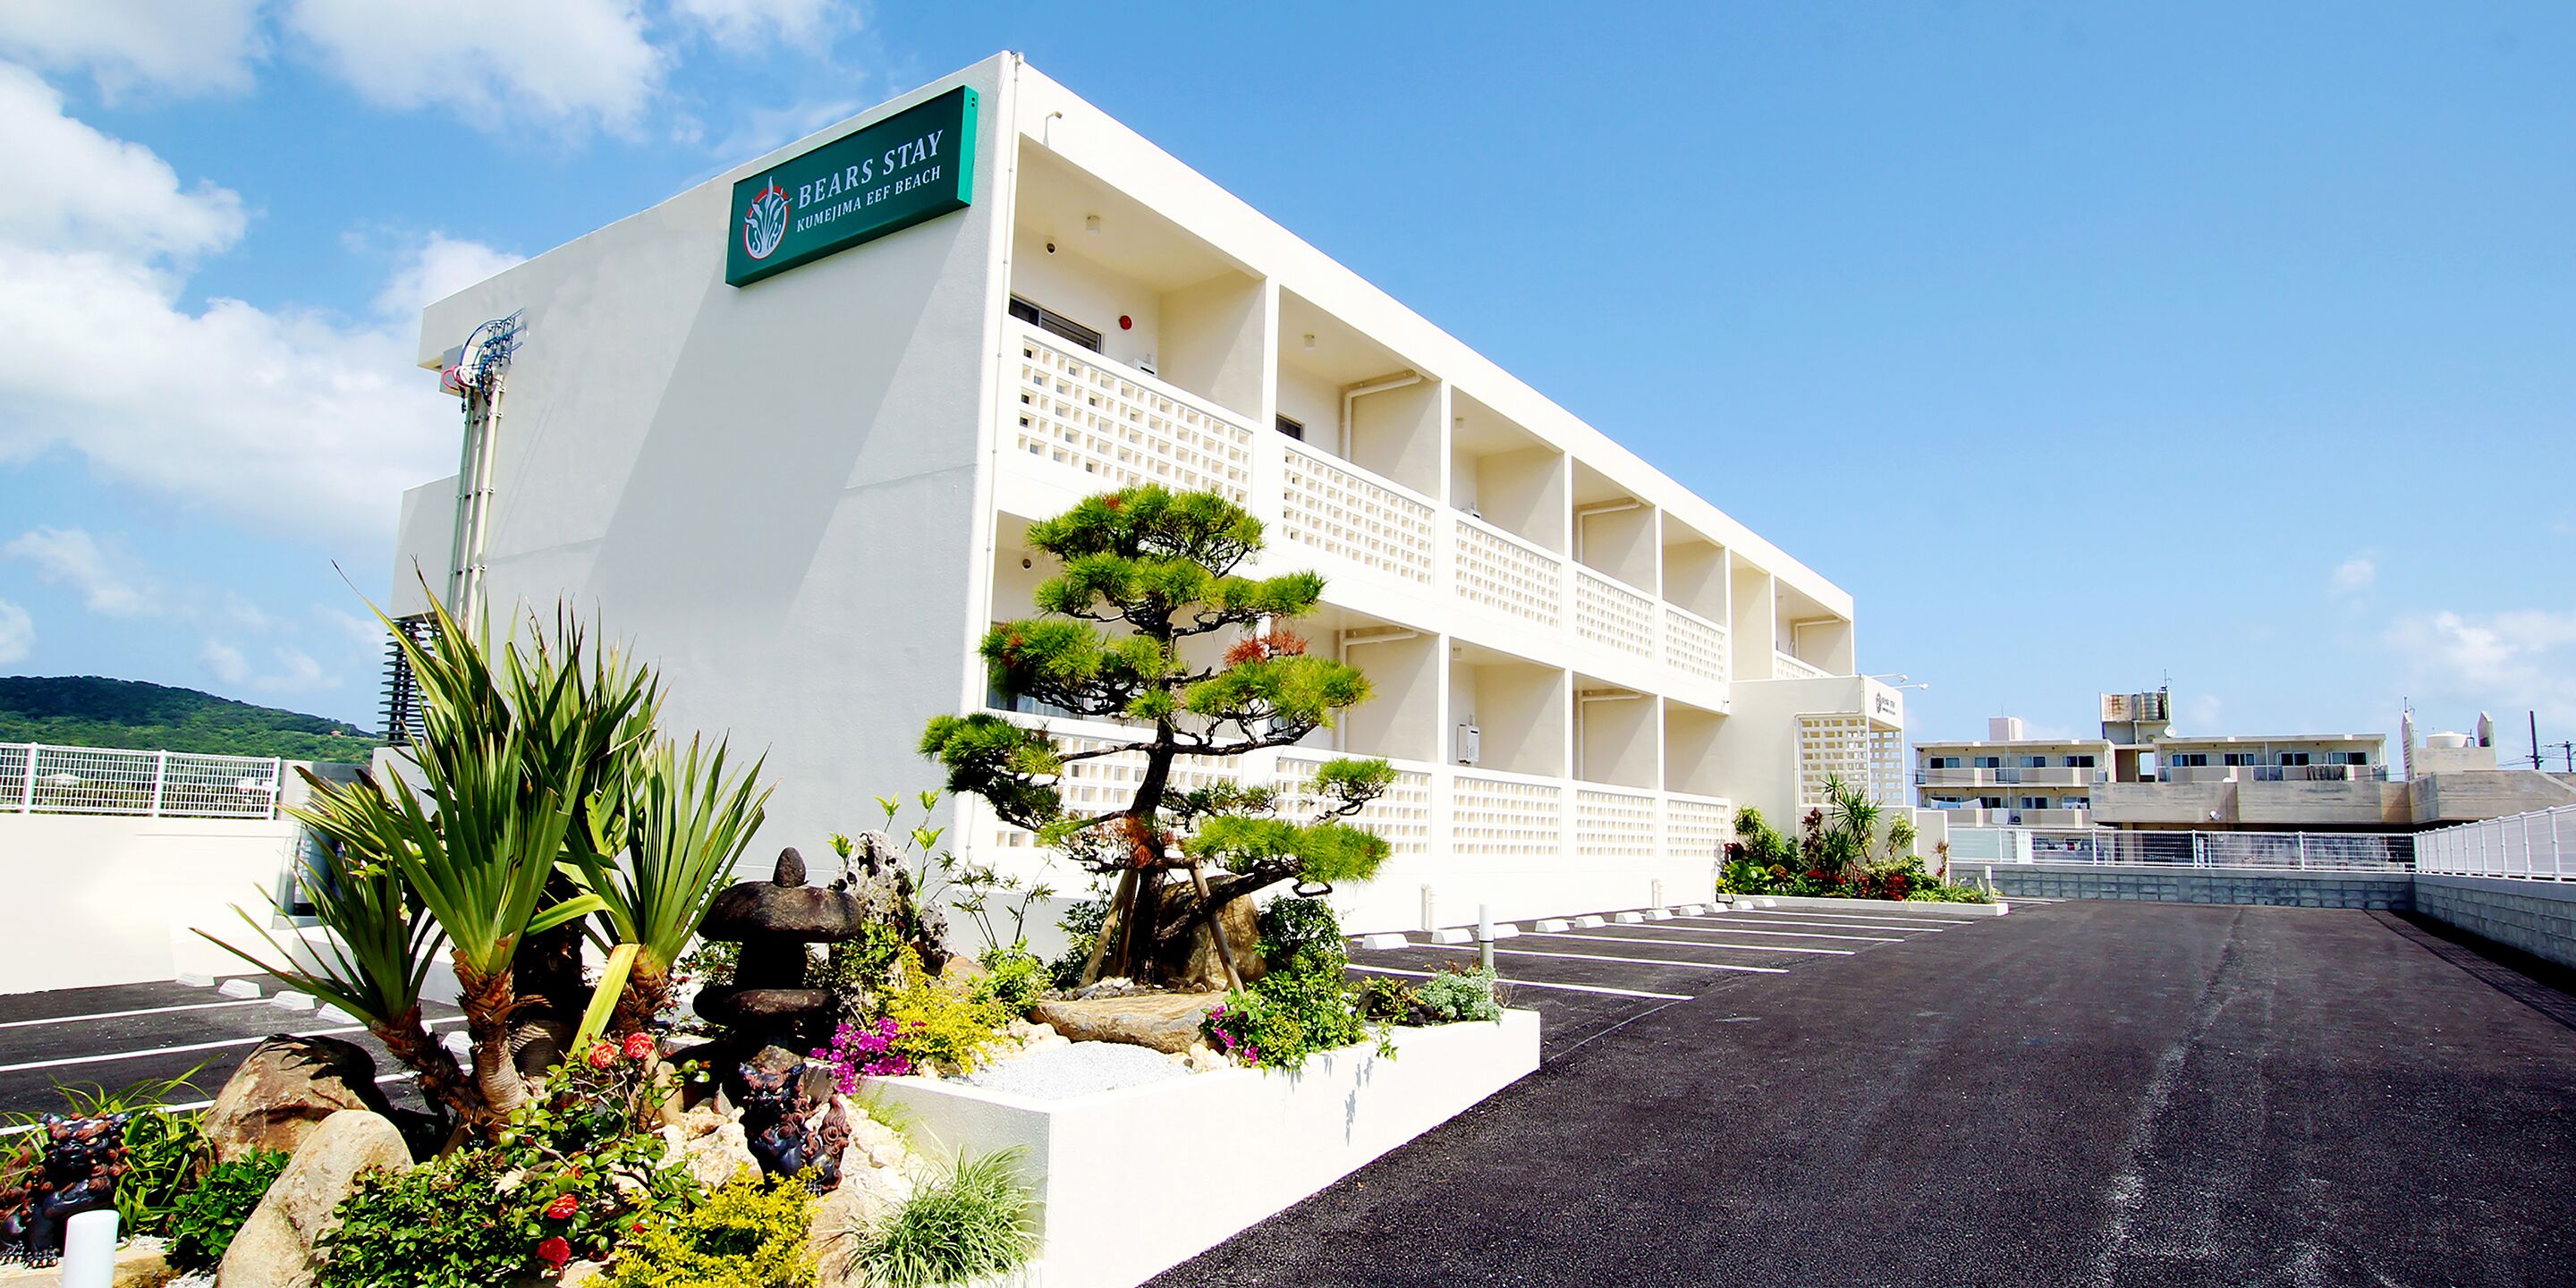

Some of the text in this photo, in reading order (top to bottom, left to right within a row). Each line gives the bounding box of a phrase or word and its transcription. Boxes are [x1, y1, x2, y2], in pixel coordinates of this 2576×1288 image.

[796, 165, 941, 233] KUMEJIMA EEF BEACH
[798, 129, 944, 209] BEARS STAY
